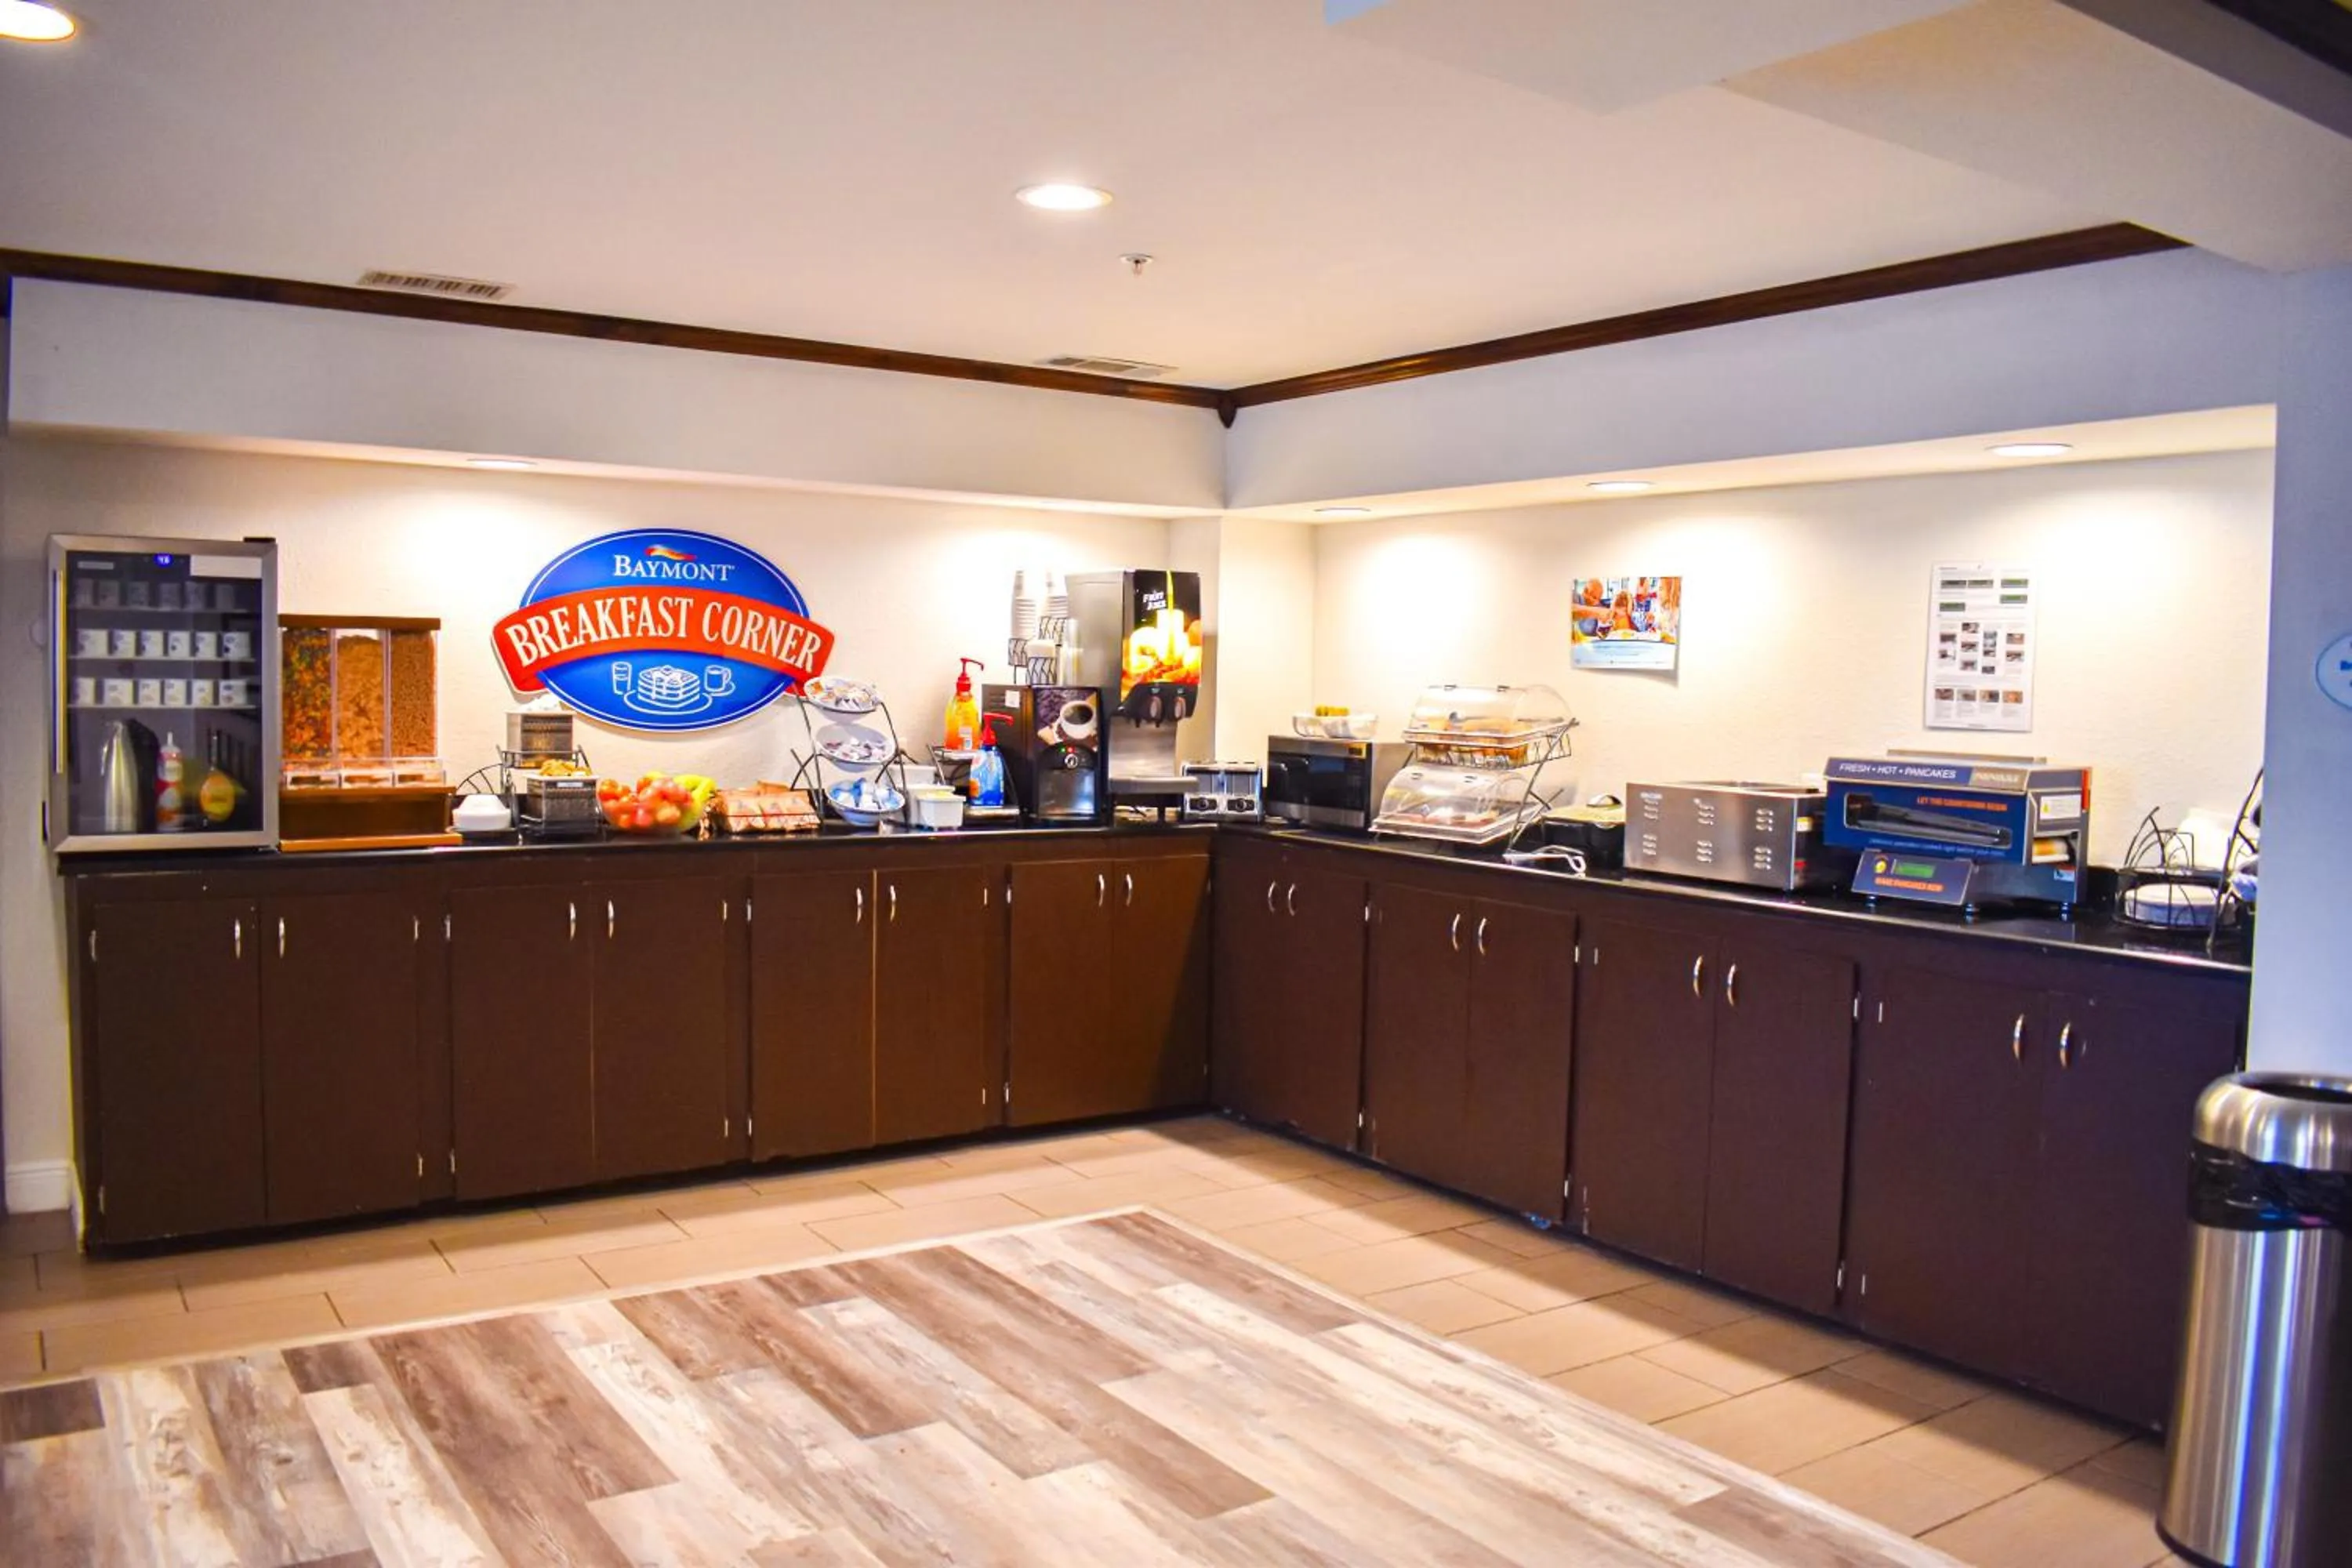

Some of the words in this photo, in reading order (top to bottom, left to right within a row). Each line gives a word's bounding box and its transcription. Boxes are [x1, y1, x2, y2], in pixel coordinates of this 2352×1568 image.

[613, 554, 731, 582] BAYMONT
[506, 596, 694, 668] BREAKFAST
[702, 601, 822, 674] CORNER
[1838, 762, 1871, 774] FRESH
[1876, 765, 1896, 775] HOT
[1904, 767, 1956, 780] PANCAKES
